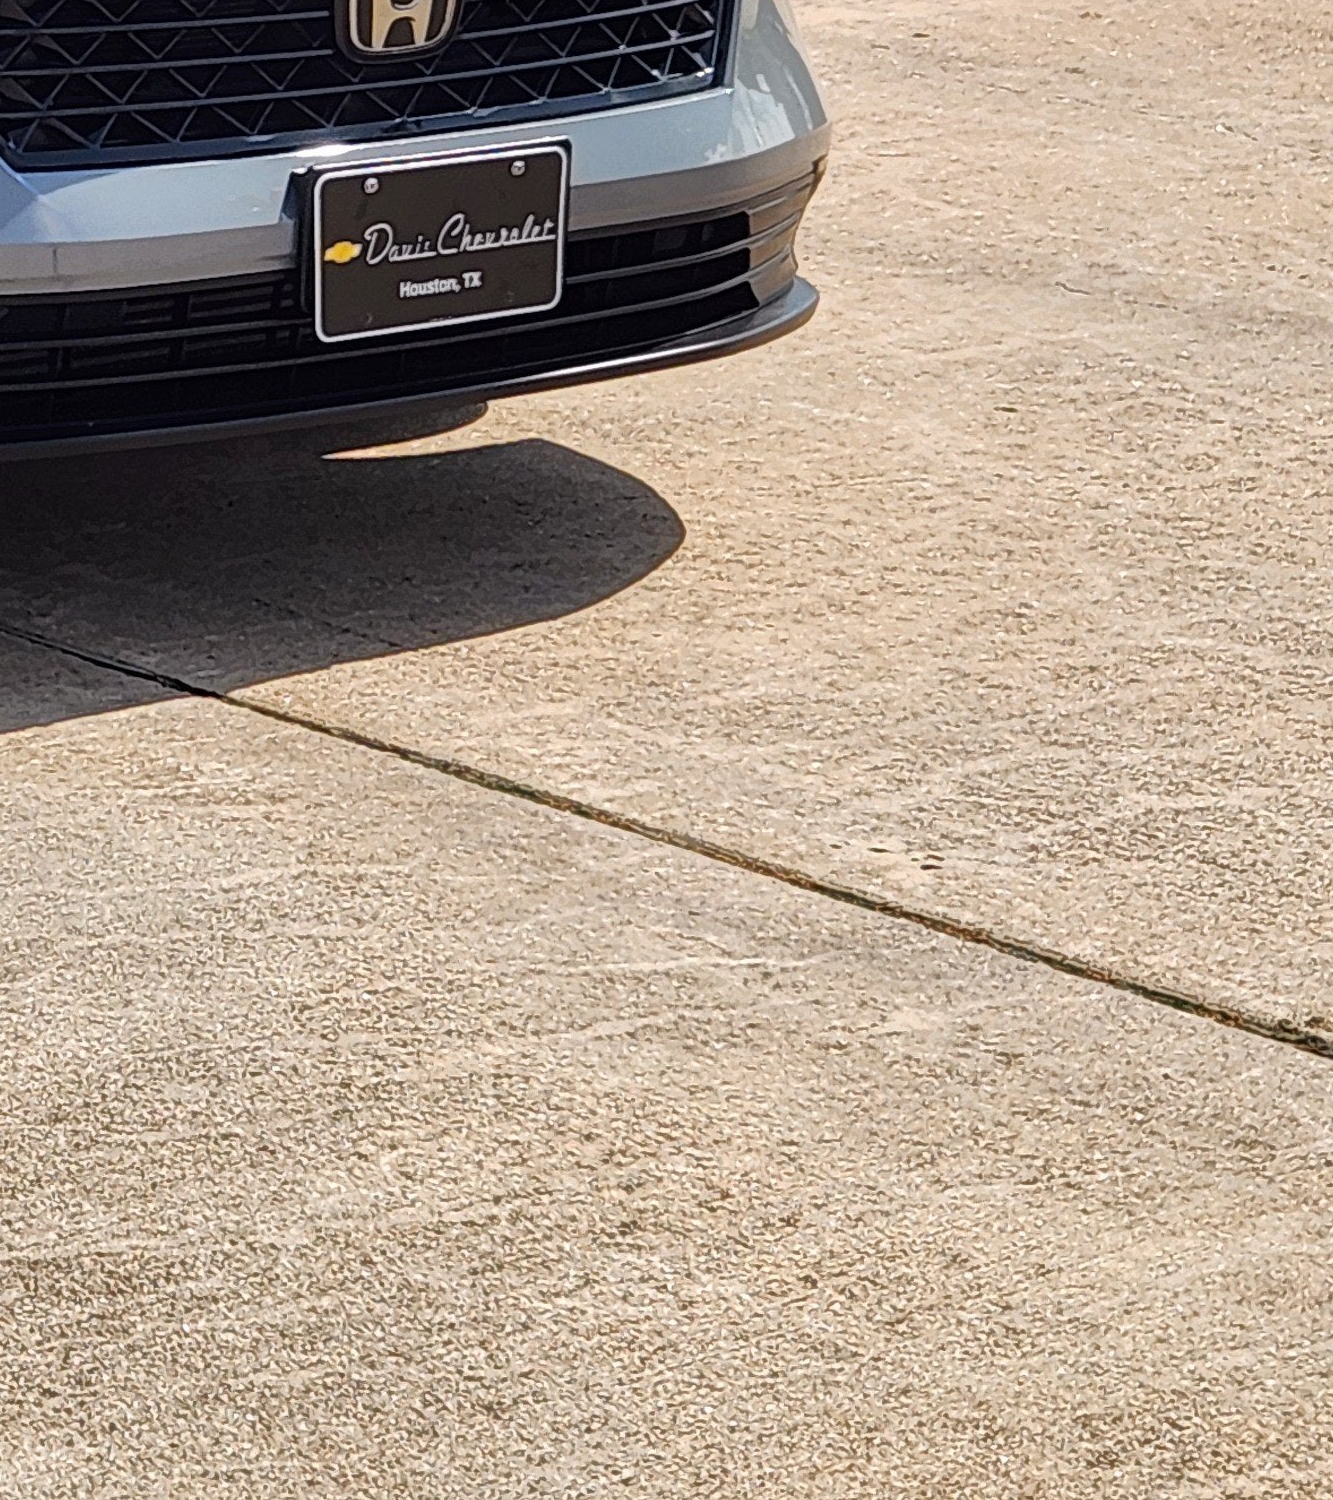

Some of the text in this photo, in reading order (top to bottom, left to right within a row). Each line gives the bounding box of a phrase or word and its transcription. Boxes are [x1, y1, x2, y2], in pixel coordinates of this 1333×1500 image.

[364, 212, 556, 265] Davis Chevrolet
[399, 271, 482, 298] Houston, TX
